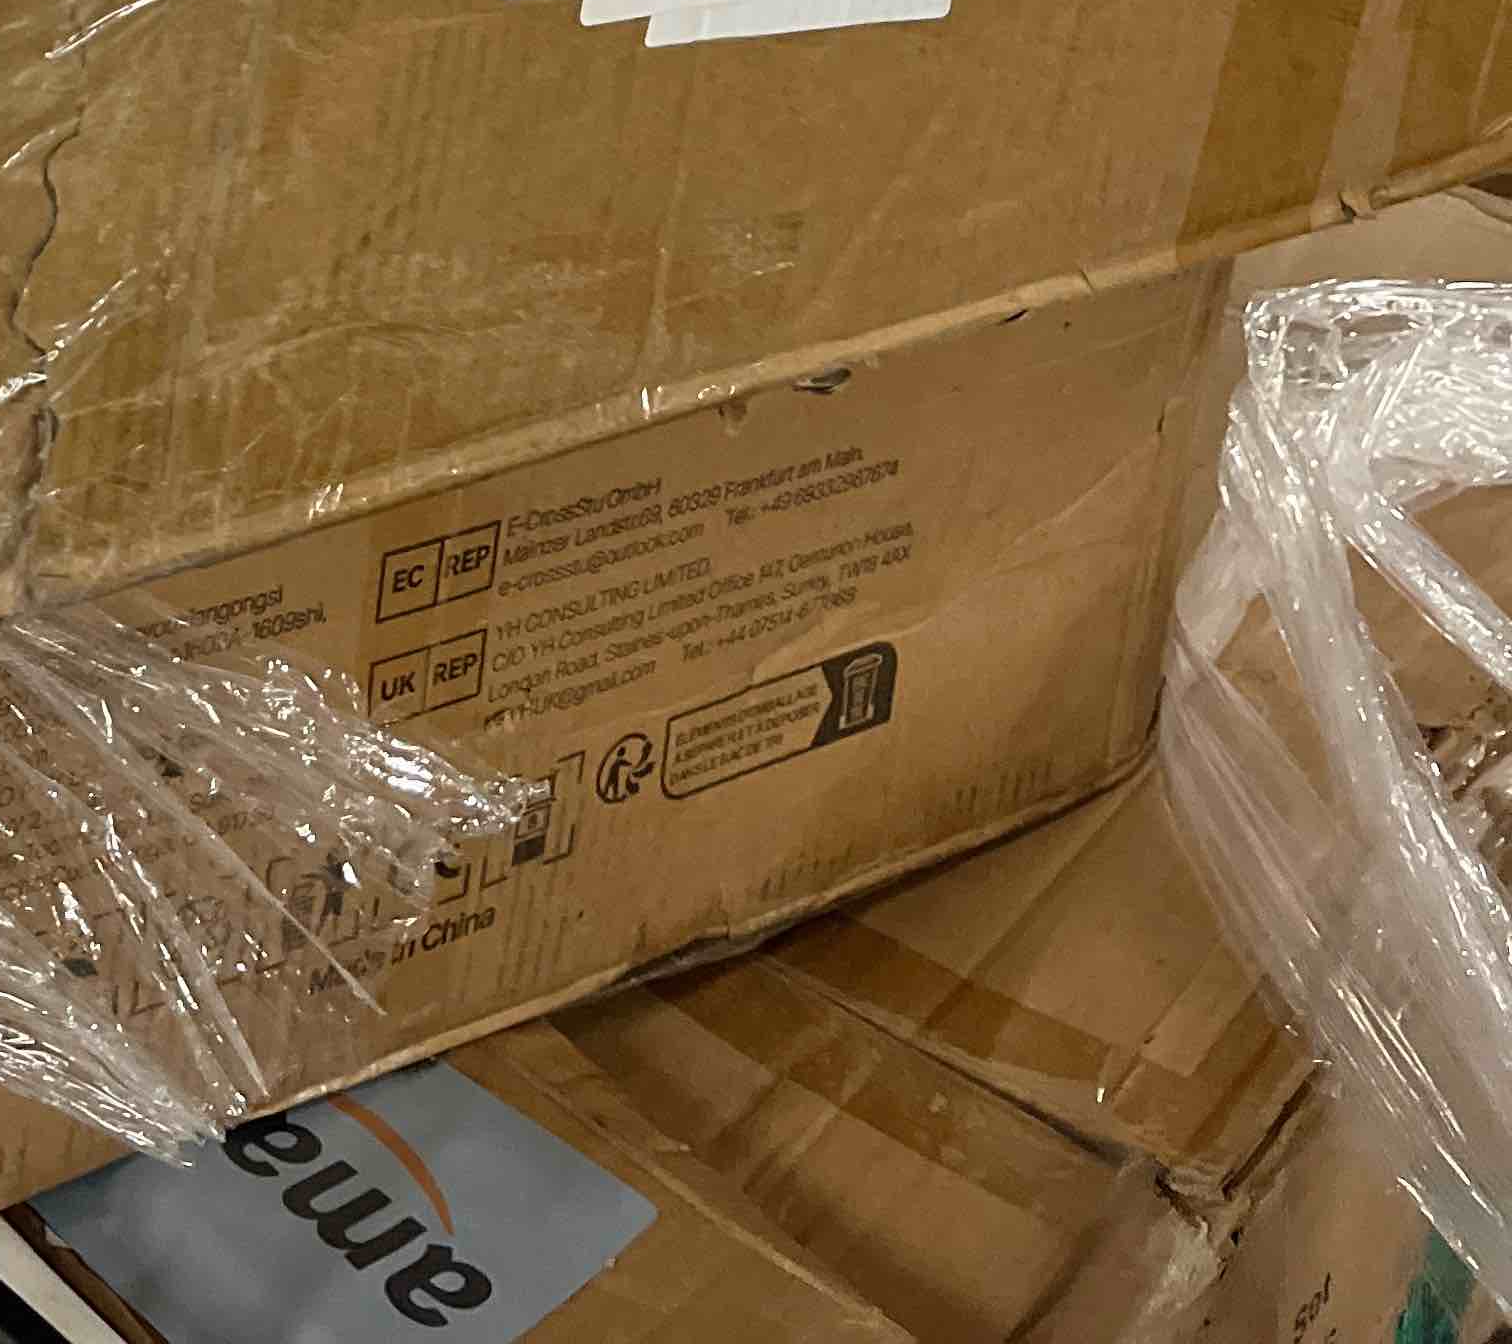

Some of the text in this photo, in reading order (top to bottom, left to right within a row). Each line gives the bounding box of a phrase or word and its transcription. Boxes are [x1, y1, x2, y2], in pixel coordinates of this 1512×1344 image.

[445, 545, 492, 578] REP
[392, 565, 425, 593] EC
[432, 653, 478, 686] REP
[381, 672, 416, 701] UK
[421, 907, 497, 952] China
[221, 1112, 493, 1328] ama
